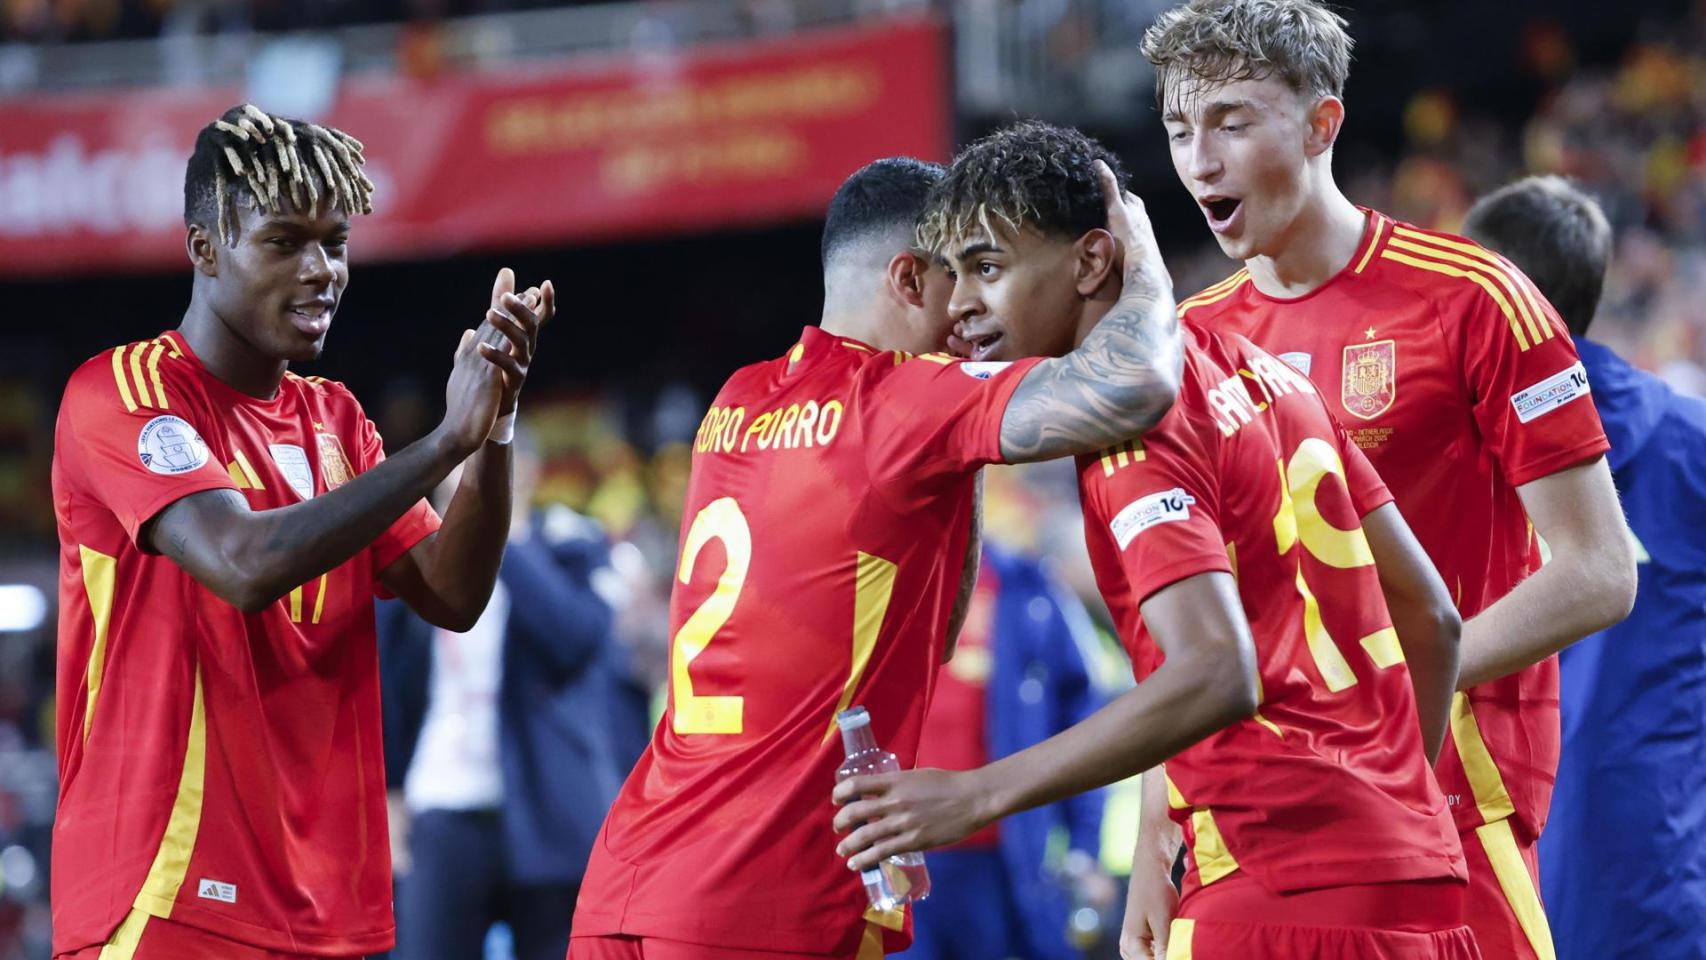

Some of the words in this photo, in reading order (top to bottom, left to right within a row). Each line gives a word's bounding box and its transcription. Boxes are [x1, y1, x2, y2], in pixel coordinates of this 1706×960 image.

[1517, 381, 1572, 412] FOUNDATION
[696, 406, 745, 454] EDRO
[740, 399, 843, 453] PORRO
[1160, 496, 1184, 513] 10
[1273, 438, 1405, 693] 19
[672, 497, 744, 735] 2
